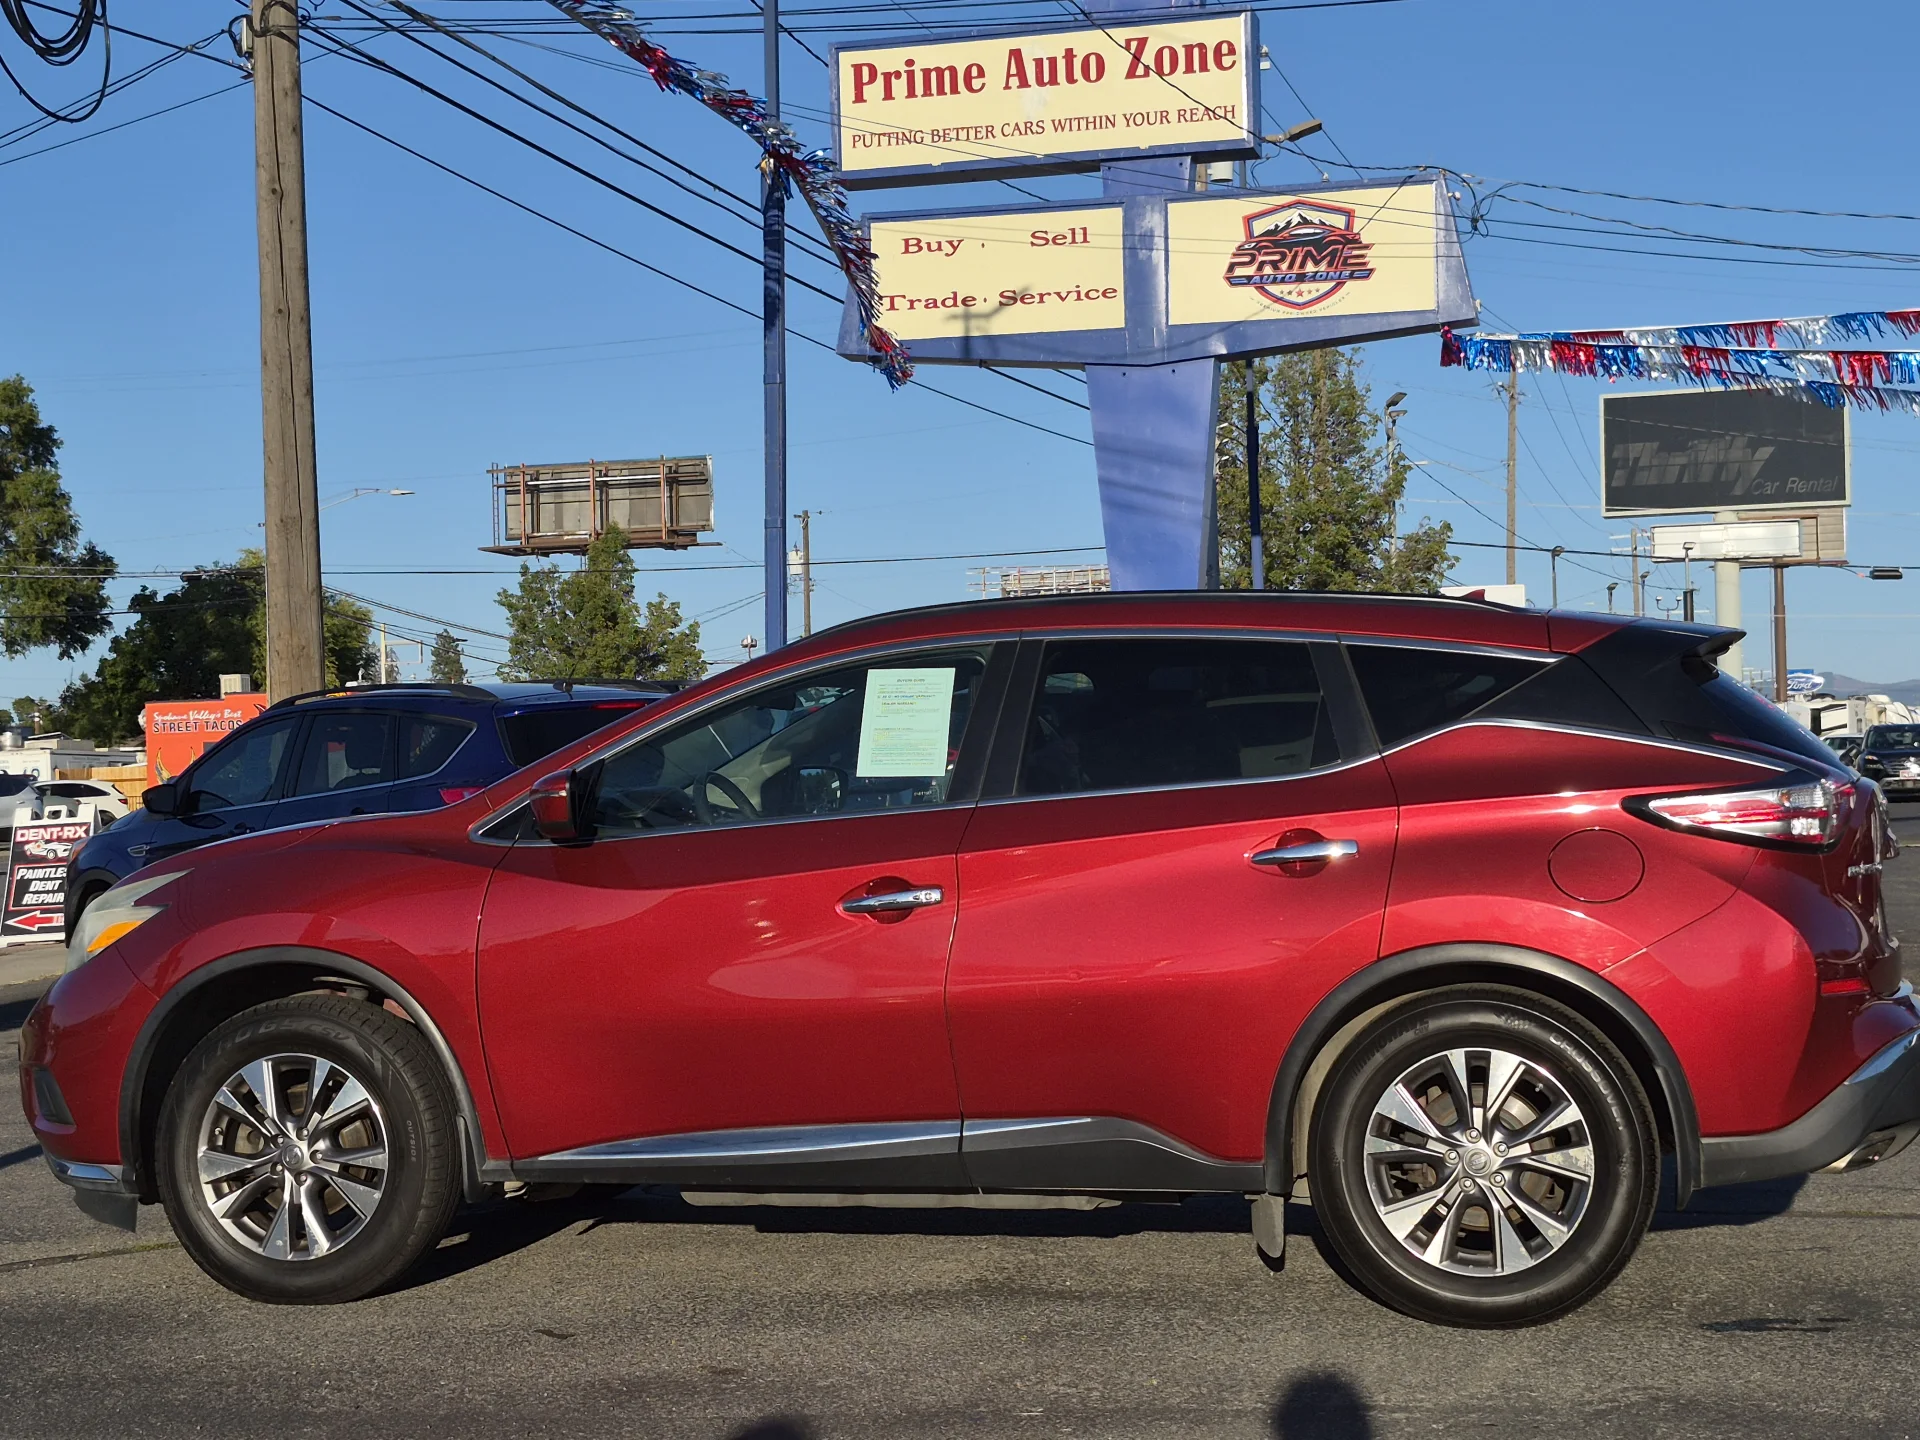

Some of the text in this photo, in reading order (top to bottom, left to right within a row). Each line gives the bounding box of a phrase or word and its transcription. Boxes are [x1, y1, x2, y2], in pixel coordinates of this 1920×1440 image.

[851, 37, 1237, 104] Prime Auto Zone
[852, 104, 1236, 149] PUTTING BETTER CARS WITHIN YOUR REACH
[901, 226, 1090, 257] Buy Sell
[1225, 243, 1375, 275] PRIME
[1250, 271, 1350, 285] AUTO ZONE
[882, 285, 1118, 312] Trade Service
[1611, 435, 1776, 495] Thrifty
[1751, 476, 1838, 495] Car Rental
[1787, 679, 1813, 690] Ford
[224, 709, 242, 718] Best
[153, 720, 243, 733] STREET TACOS
[15, 825, 88, 842] DENT-RX
[29, 880, 62, 892] DENT
[406, 1120, 417, 1162] OUTSIDE
